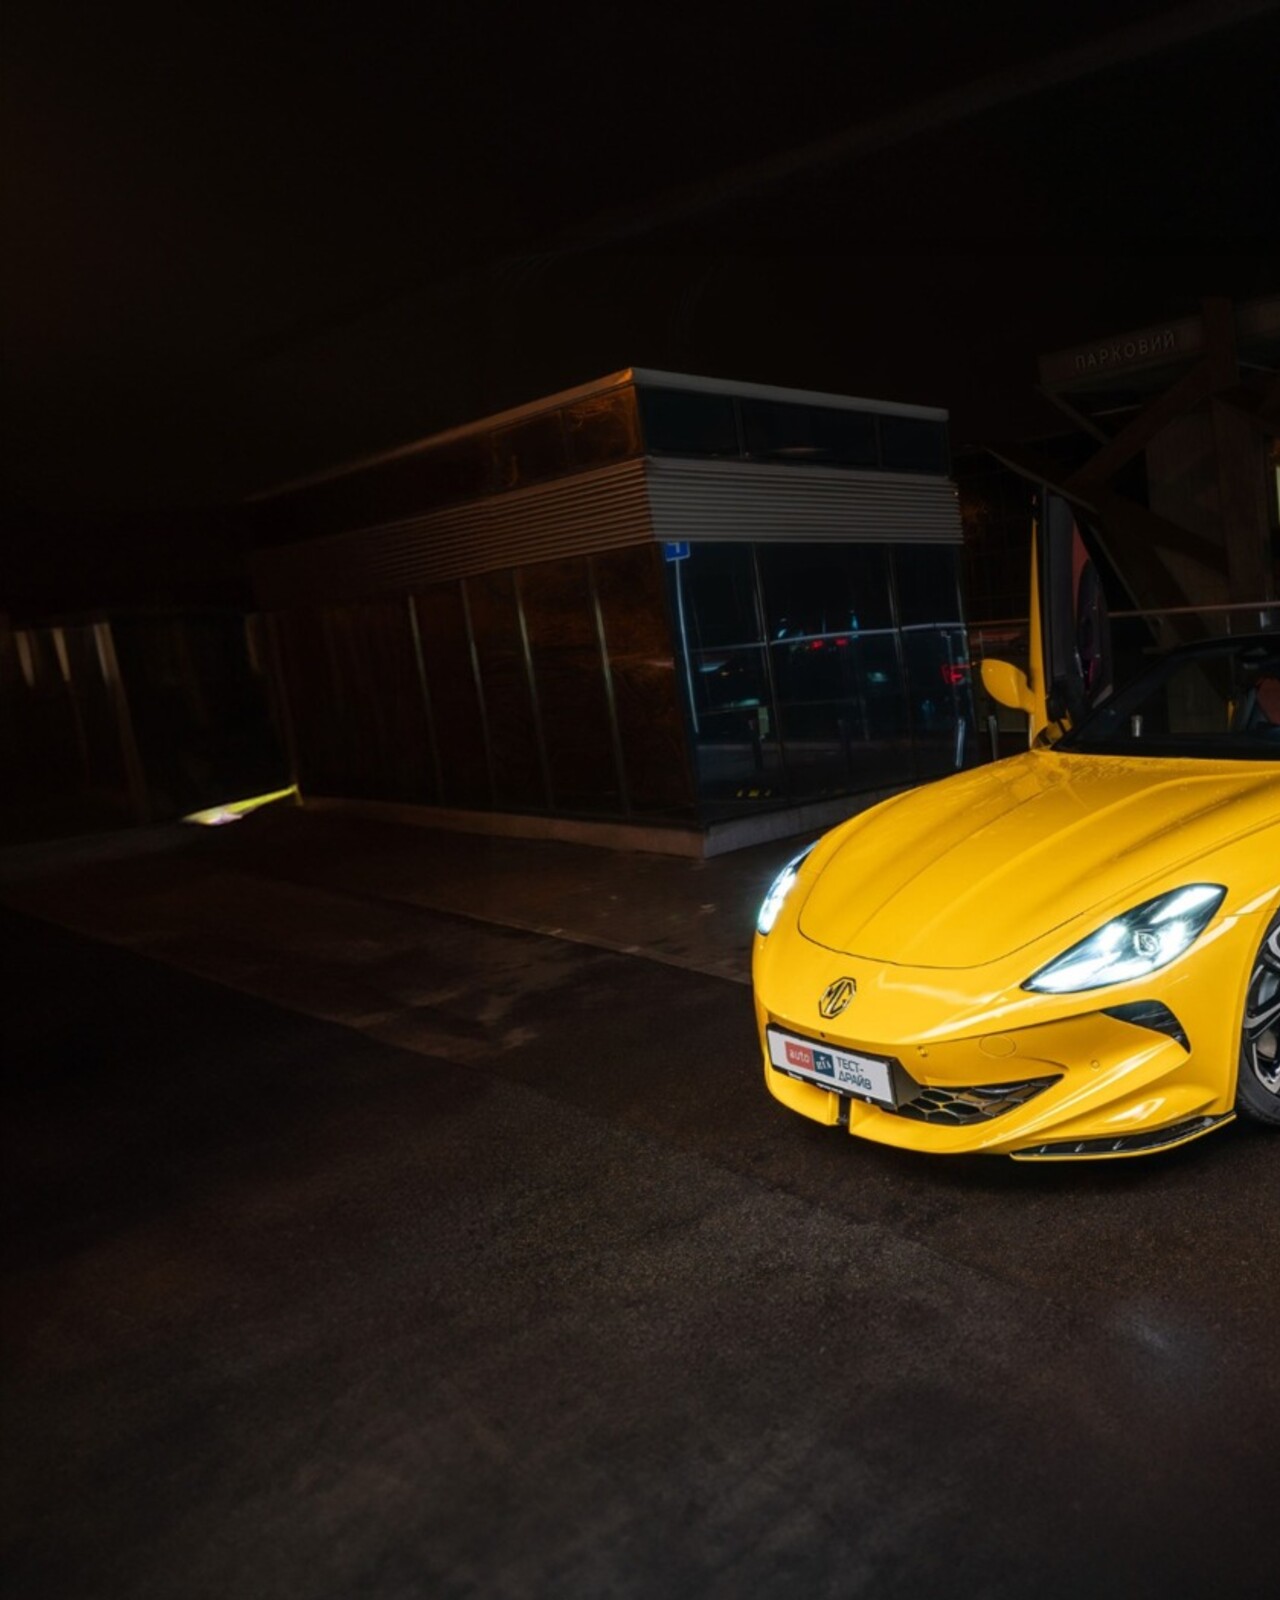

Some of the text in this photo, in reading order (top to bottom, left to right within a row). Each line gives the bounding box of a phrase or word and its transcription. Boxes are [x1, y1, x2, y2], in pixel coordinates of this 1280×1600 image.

[1074, 330, 1175, 369] ПАРКОВИЙ
[818, 976, 856, 1020] MG
[789, 1049, 810, 1063] auto
[836, 1055, 864, 1073] ТЕСТ-
[838, 1070, 872, 1090] ДРАЙВ
